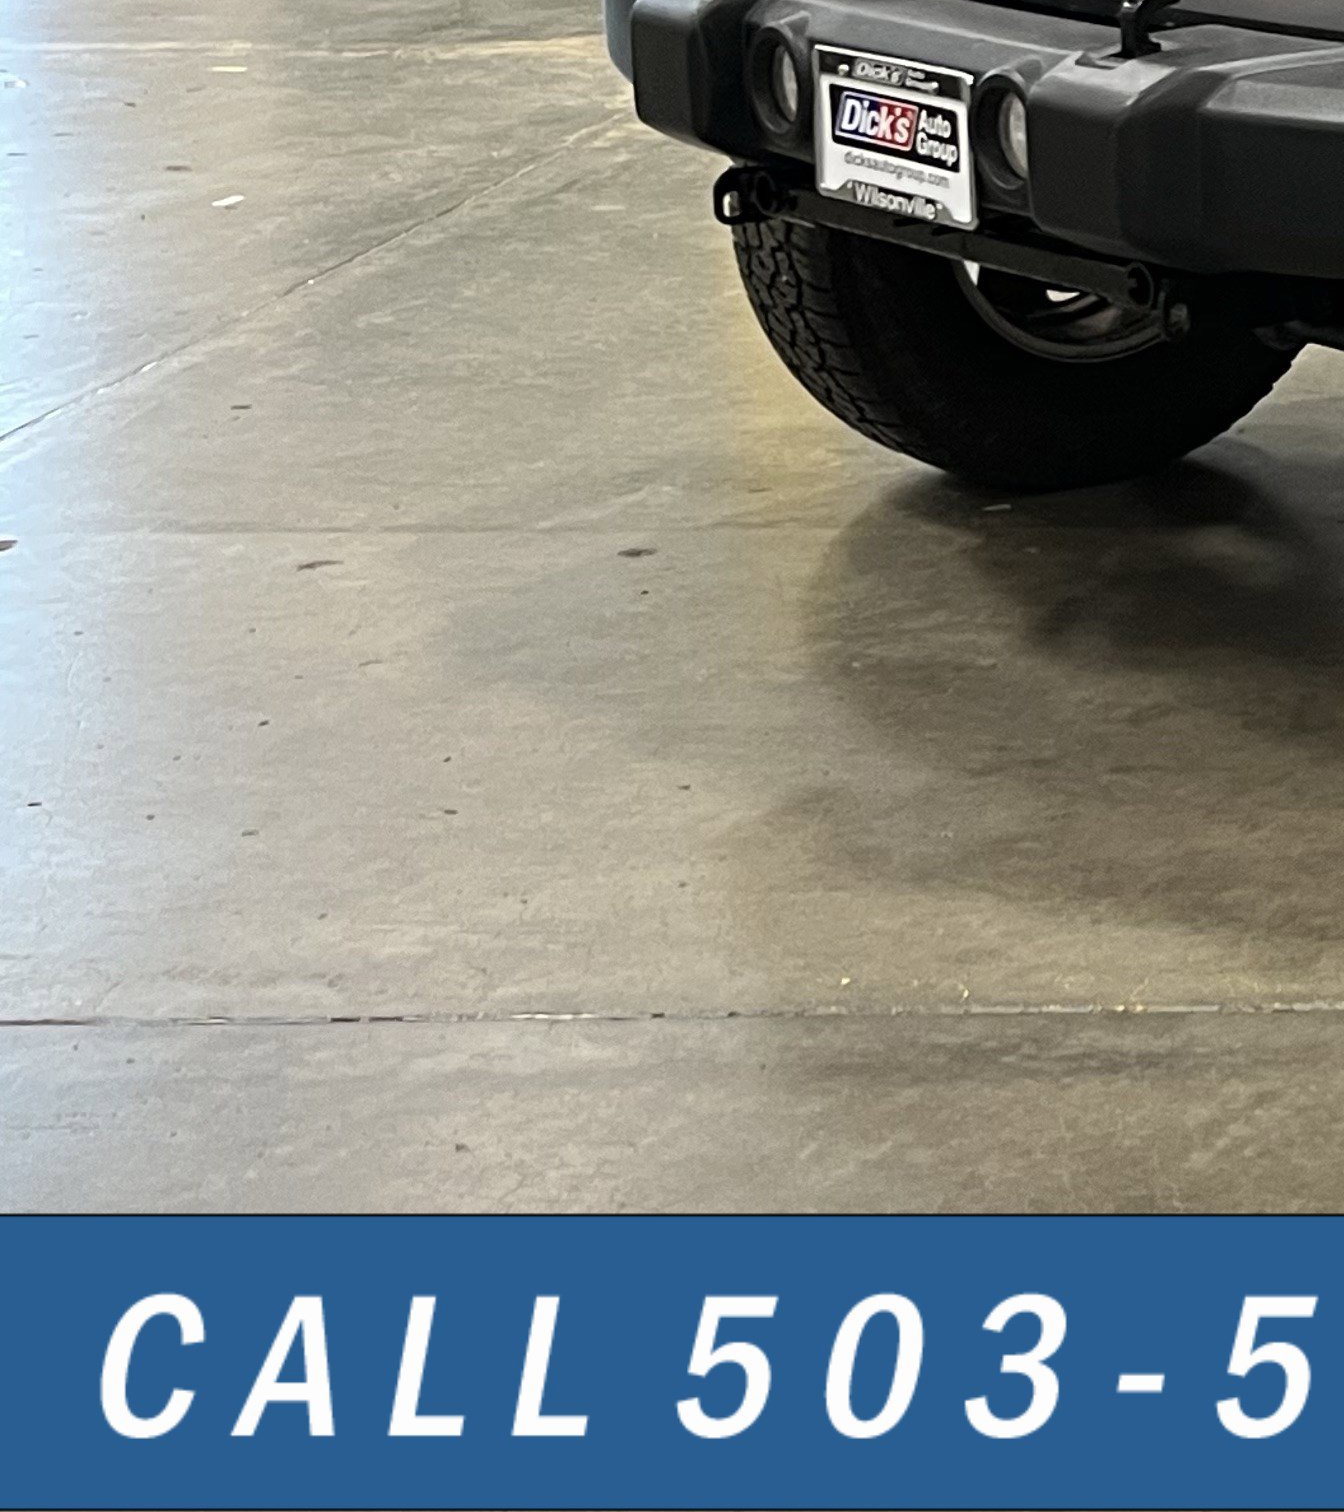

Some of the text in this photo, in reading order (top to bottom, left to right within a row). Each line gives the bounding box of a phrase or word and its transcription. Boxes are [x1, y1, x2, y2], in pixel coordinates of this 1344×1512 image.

[840, 98, 912, 144] Dick's
[919, 109, 952, 139] Auto
[916, 131, 958, 167] Group
